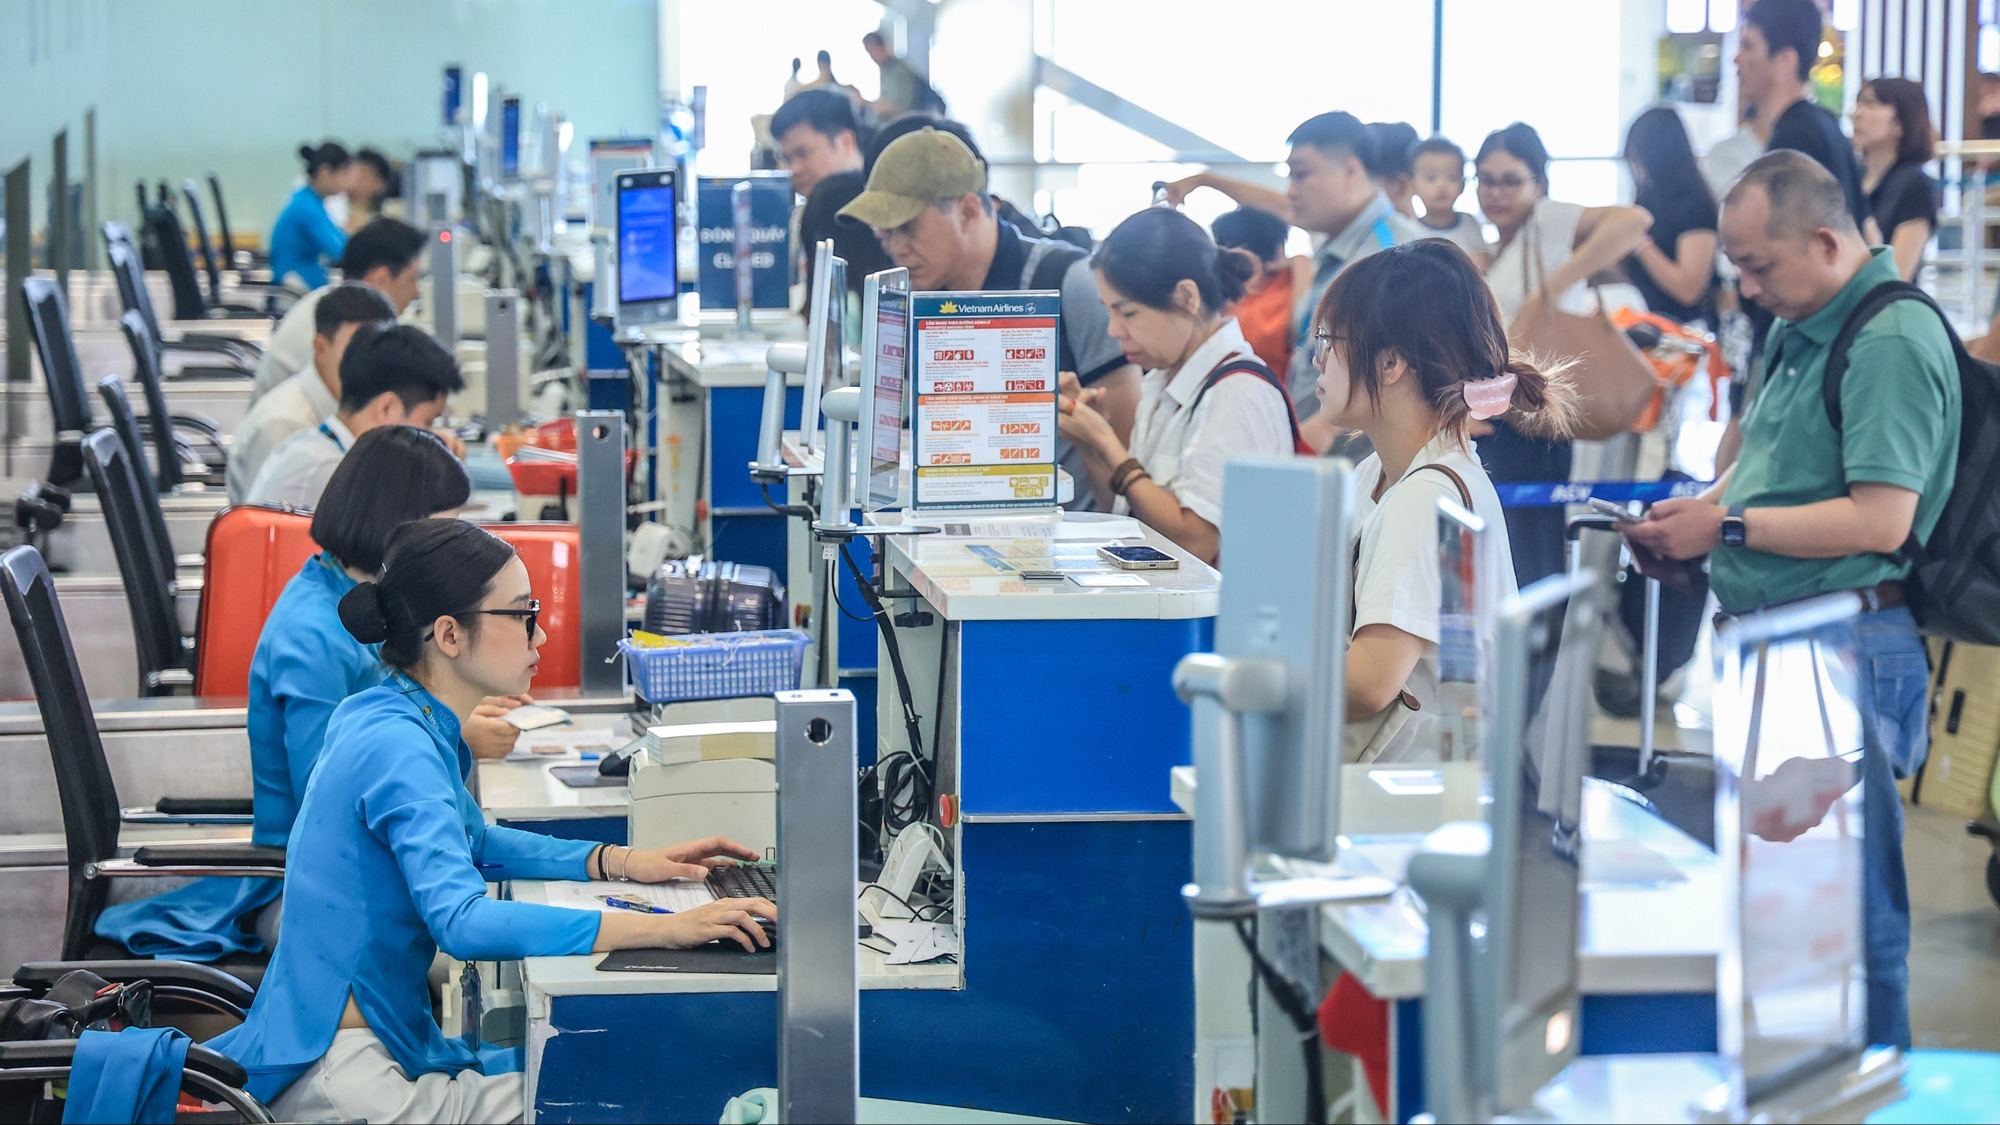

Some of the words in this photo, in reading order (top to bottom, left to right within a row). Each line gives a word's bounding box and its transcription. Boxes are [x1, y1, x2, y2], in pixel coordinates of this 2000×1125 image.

[713, 252, 774, 268] CLED
[958, 304, 992, 313] Vietnam
[993, 303, 1024, 312] Airlines
